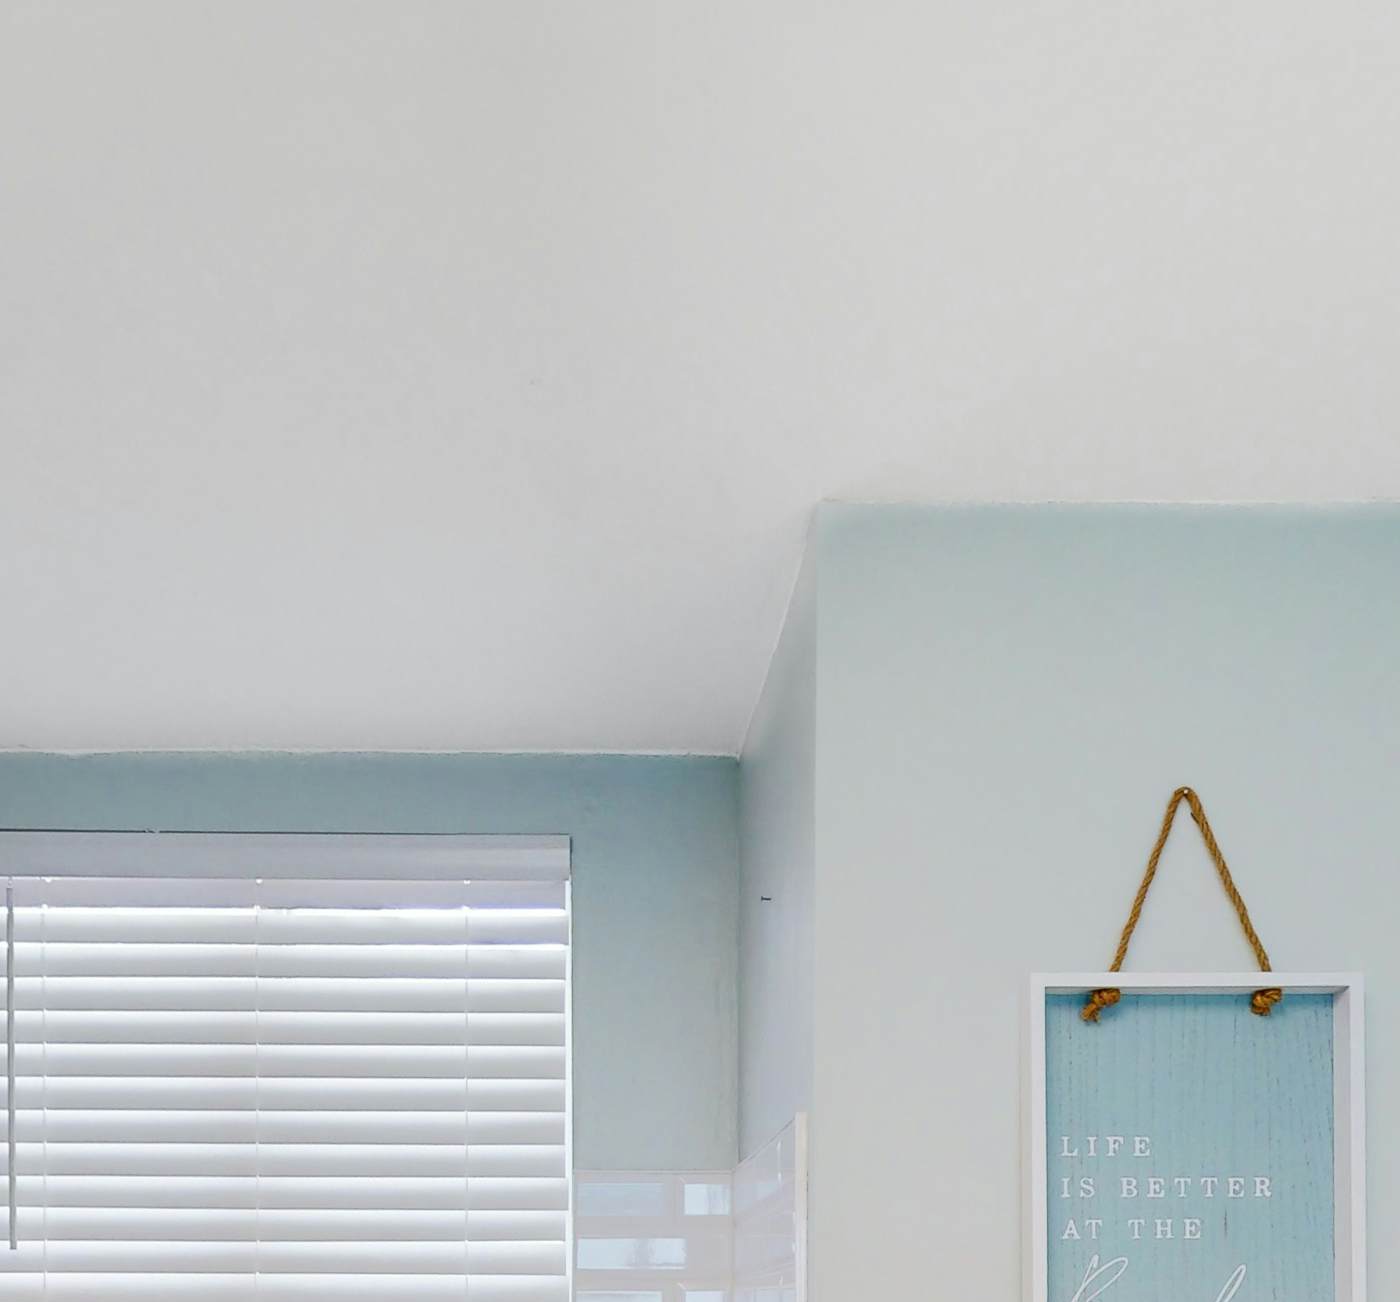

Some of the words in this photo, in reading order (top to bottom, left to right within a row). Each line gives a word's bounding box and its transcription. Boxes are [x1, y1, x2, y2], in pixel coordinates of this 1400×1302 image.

[1060, 1136, 1151, 1157] LIFE
[1060, 1177, 1096, 1199] IS
[1120, 1176, 1272, 1198] BETTER
[1061, 1219, 1103, 1240] AT
[1127, 1219, 1201, 1240] THE
